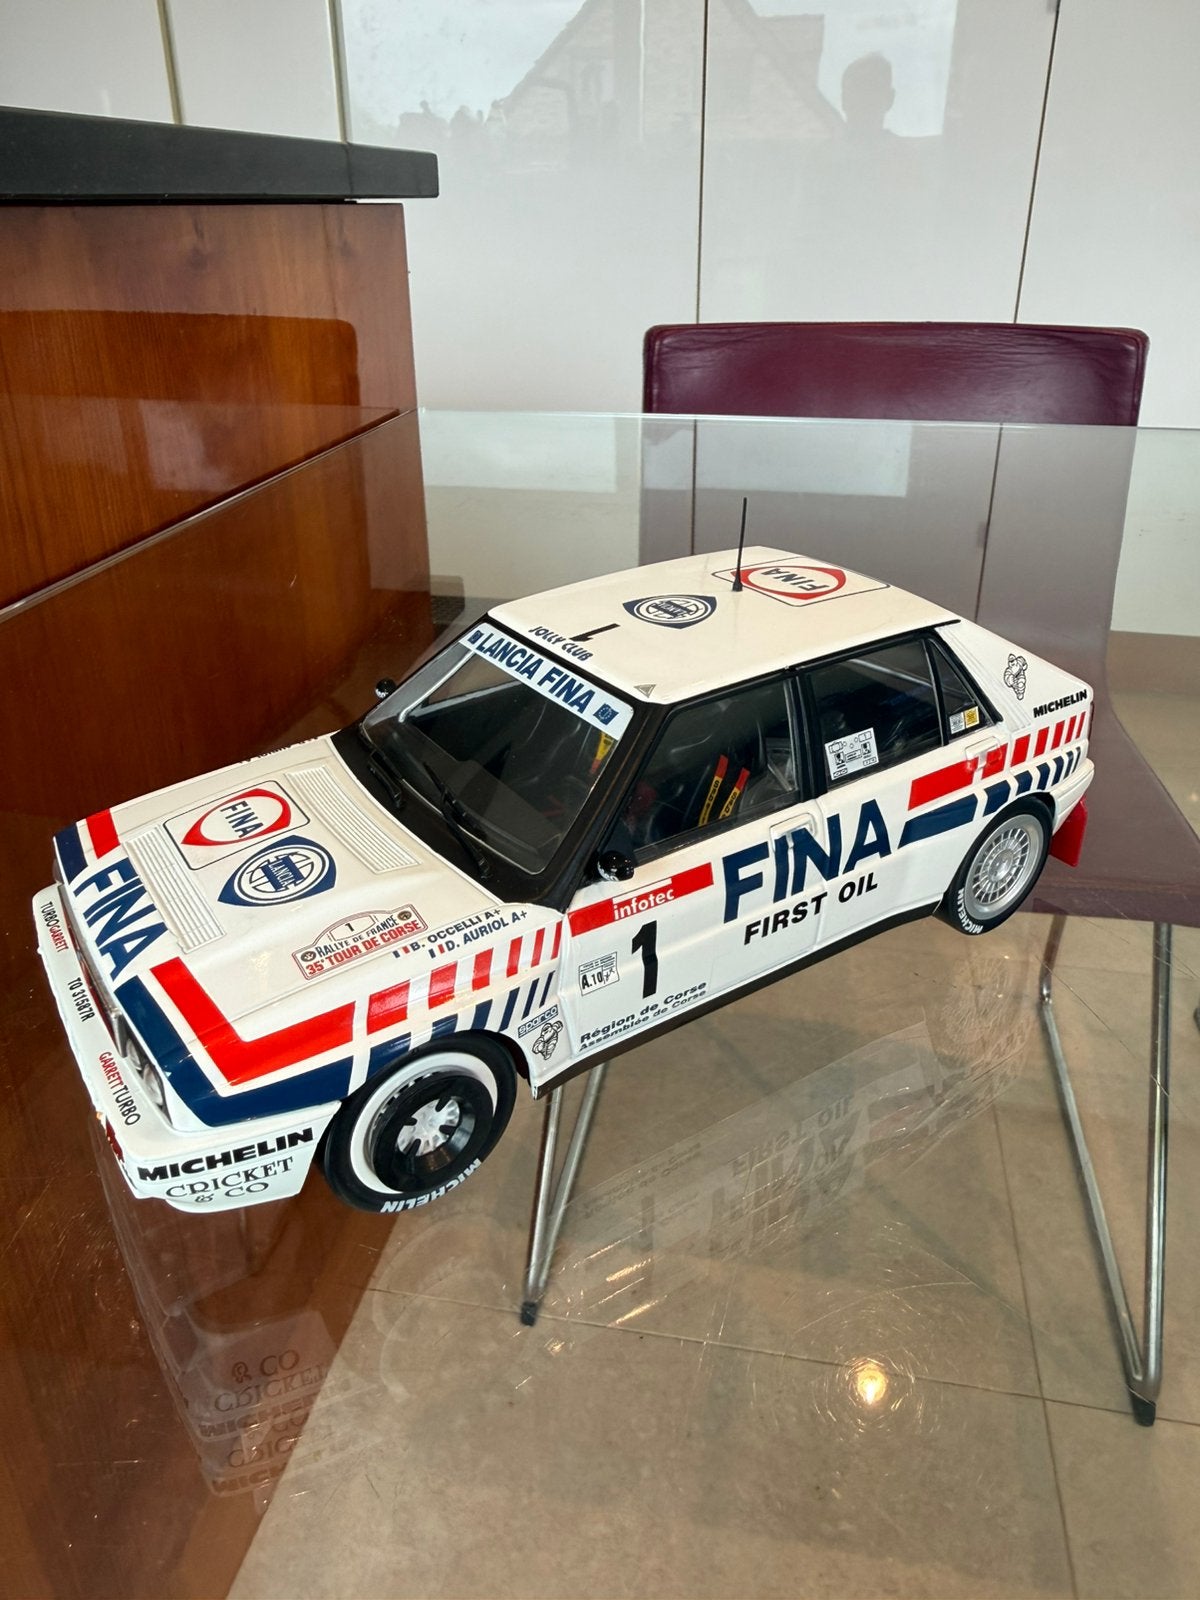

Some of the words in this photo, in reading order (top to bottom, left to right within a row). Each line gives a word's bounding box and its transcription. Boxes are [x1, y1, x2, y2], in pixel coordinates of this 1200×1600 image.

[760, 568, 830, 592] FINA
[528, 624, 565, 645] JOLLY
[561, 642, 594, 662] CLUB
[569, 622, 621, 642] 1
[474, 632, 544, 680] LANCIA
[537, 666, 596, 714] FINA
[1033, 688, 1088, 719] MICHELIN
[220, 800, 264, 839] FINA
[268, 859, 296, 888] LANCIA
[722, 798, 892, 924] FINA
[73, 857, 168, 982] FINA
[613, 888, 675, 921] infotec
[744, 892, 828, 946] FIRST
[838, 871, 879, 904] OIL
[957, 887, 984, 934] MICHELIN
[314, 937, 351, 959] RALLYE
[352, 933, 364, 944] DE
[364, 915, 399, 938] FRANCE
[327, 944, 362, 967] TOUR
[363, 937, 380, 953] DE
[380, 919, 422, 943] CORSE
[345, 922, 354, 932] 1
[410, 937, 426, 951] B.
[427, 914, 482, 942] OCCELLI
[484, 908, 501, 922] A+
[445, 939, 461, 952] D.
[462, 917, 509, 944] AURIOL
[511, 909, 528, 923] A+
[631, 919, 659, 999] 1
[67, 976, 84, 991] TO
[519, 1005, 558, 1036] sparco
[579, 1015, 650, 1052] Assemblée
[653, 1006, 669, 1018] de
[671, 990, 707, 1009] Corse
[580, 1012, 636, 1044] Région
[639, 1002, 660, 1016] de
[663, 982, 707, 1005] Corse
[138, 1127, 314, 1182] MICHELIN
[165, 1156, 295, 1199] CRICKET
[223, 1181, 270, 1198] CO
[380, 1158, 482, 1213] MICHELIN
